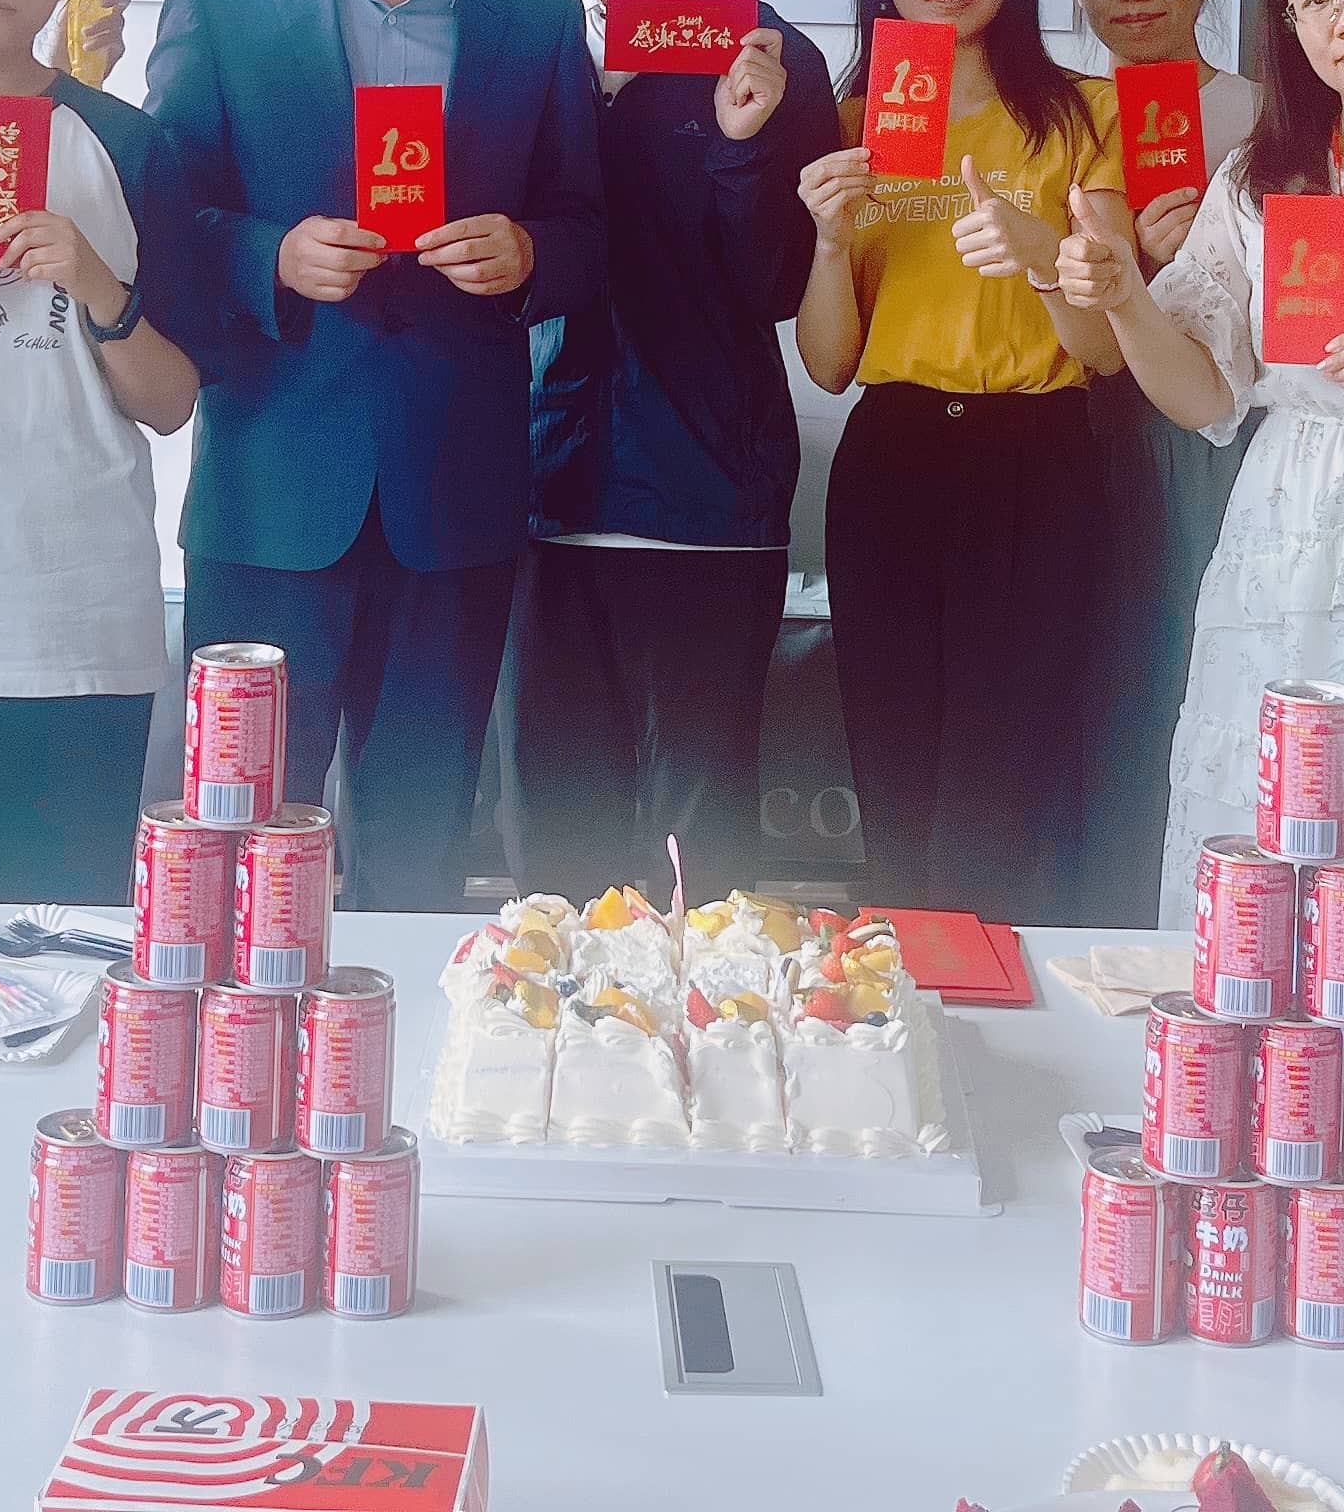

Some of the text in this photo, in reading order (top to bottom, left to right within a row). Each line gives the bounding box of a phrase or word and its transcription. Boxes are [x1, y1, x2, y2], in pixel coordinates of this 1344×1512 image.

[874, 181, 921, 195] ENJOY
[979, 170, 1009, 184] IFE
[855, 190, 1034, 230] ADVENTE
[1196, 1219, 1249, 1252] 牛奶
[1199, 1265, 1243, 1283] DRINK
[1199, 1280, 1243, 1299] MILK
[264, 1451, 440, 1490] KFC
